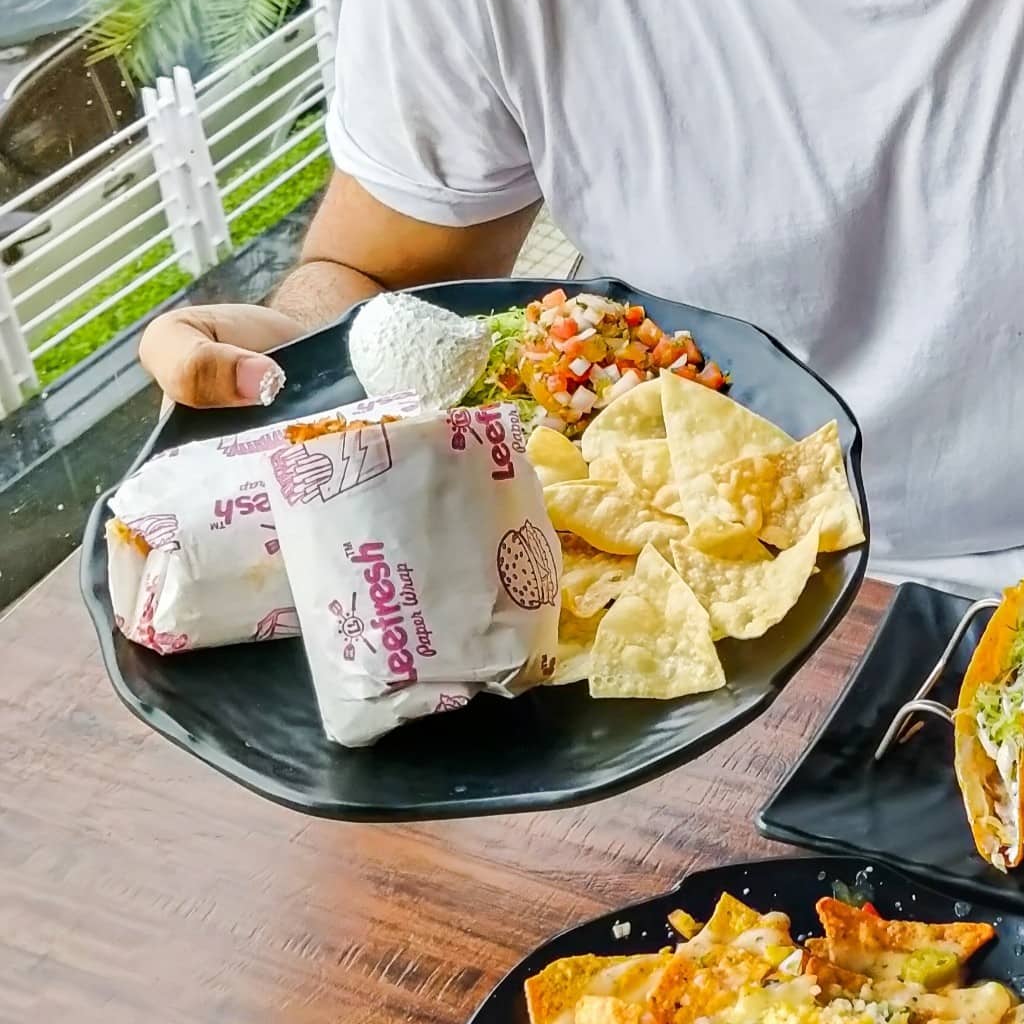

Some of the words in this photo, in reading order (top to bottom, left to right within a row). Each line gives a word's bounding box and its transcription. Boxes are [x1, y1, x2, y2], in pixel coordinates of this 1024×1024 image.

[397, 562, 418, 606] Wrap
[350, 542, 418, 689] Leefresh
[411, 610, 437, 657] Paper
